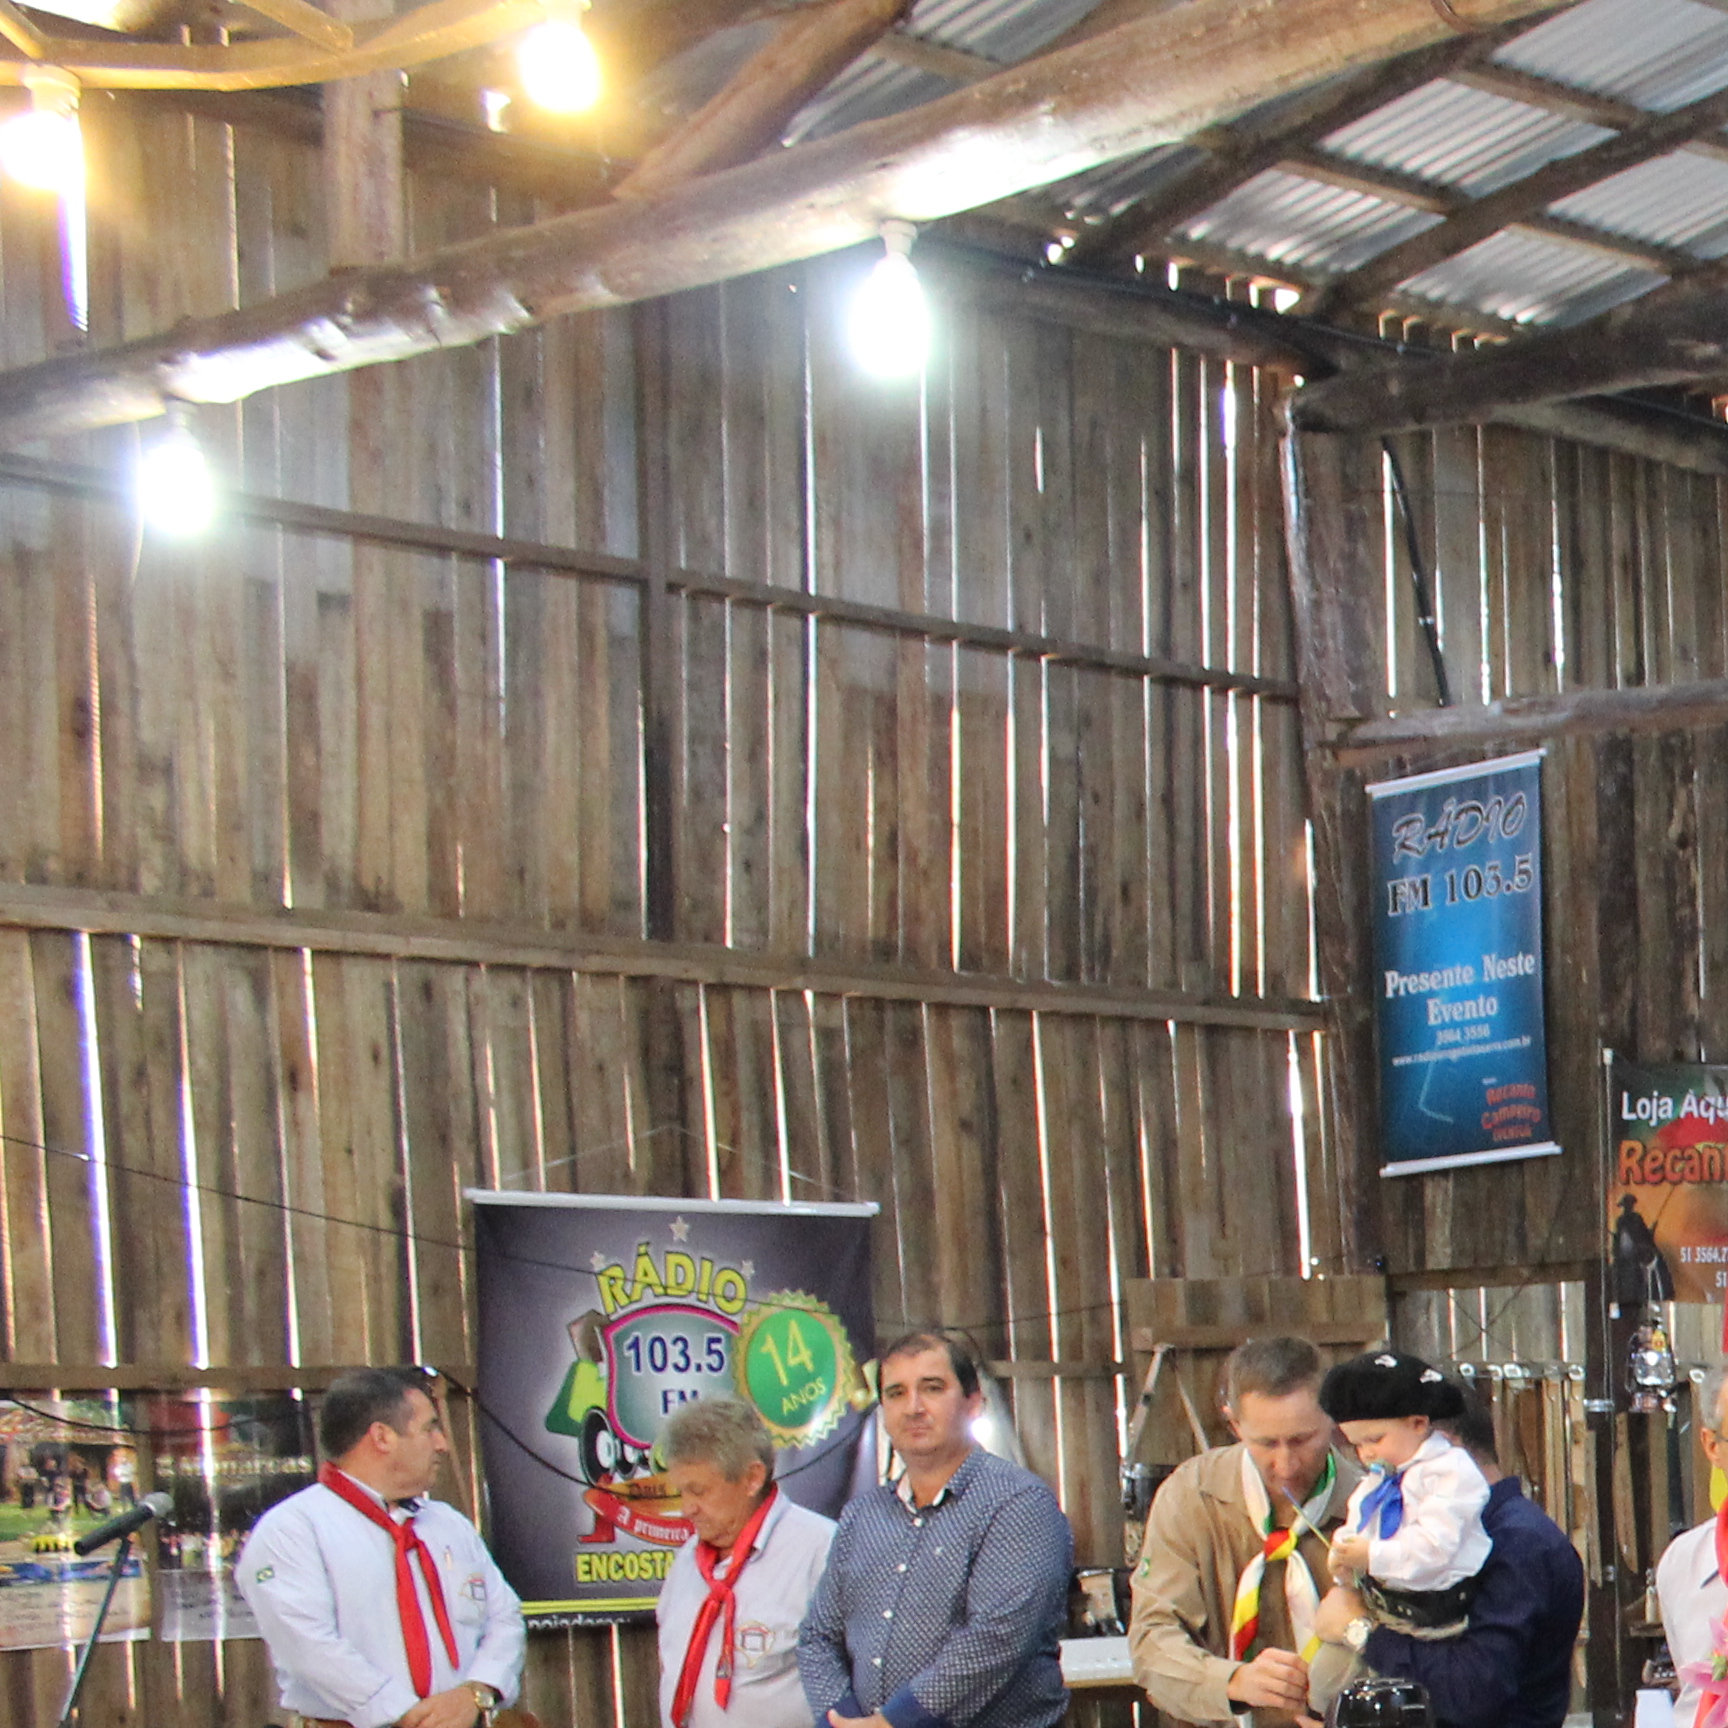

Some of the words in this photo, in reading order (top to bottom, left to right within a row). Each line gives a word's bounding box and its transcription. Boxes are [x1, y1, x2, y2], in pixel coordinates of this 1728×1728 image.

[1392, 792, 1526, 864] RÁDIO
[1387, 874, 1432, 917] FM
[1444, 853, 1532, 904] 103.5
[1384, 965, 1475, 998] Presente
[1482, 952, 1536, 983] Neste
[1426, 996, 1498, 1026] Evento
[1621, 1090, 1674, 1127] Loja
[596, 1242, 747, 1314] RÁDIO
[624, 1334, 725, 1374] 103.5
[761, 1319, 815, 1387] 14
[781, 1376, 826, 1415] ANOS
